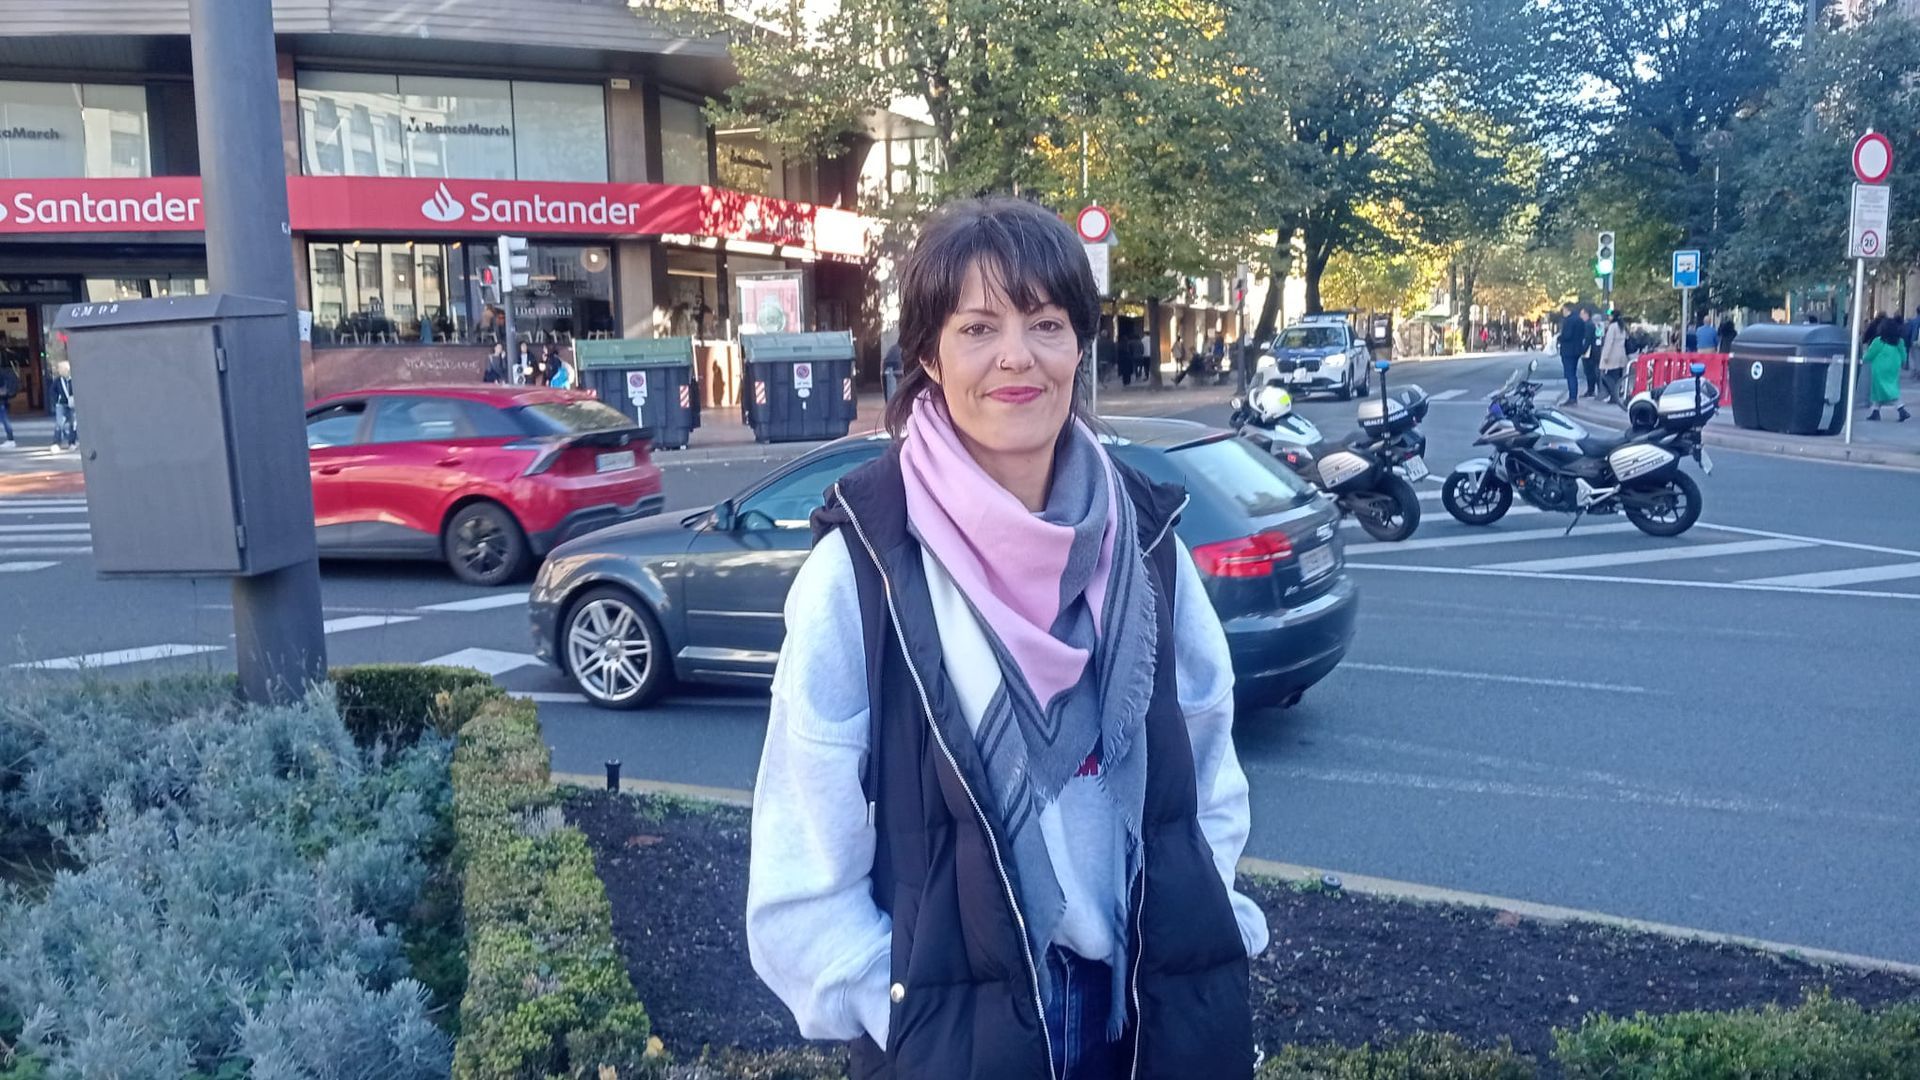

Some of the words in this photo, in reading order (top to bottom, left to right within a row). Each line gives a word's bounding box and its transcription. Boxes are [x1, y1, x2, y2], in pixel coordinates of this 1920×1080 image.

[424, 122, 511, 137] BancaMarch
[14, 192, 200, 224] Santander
[470, 191, 641, 225] Santander
